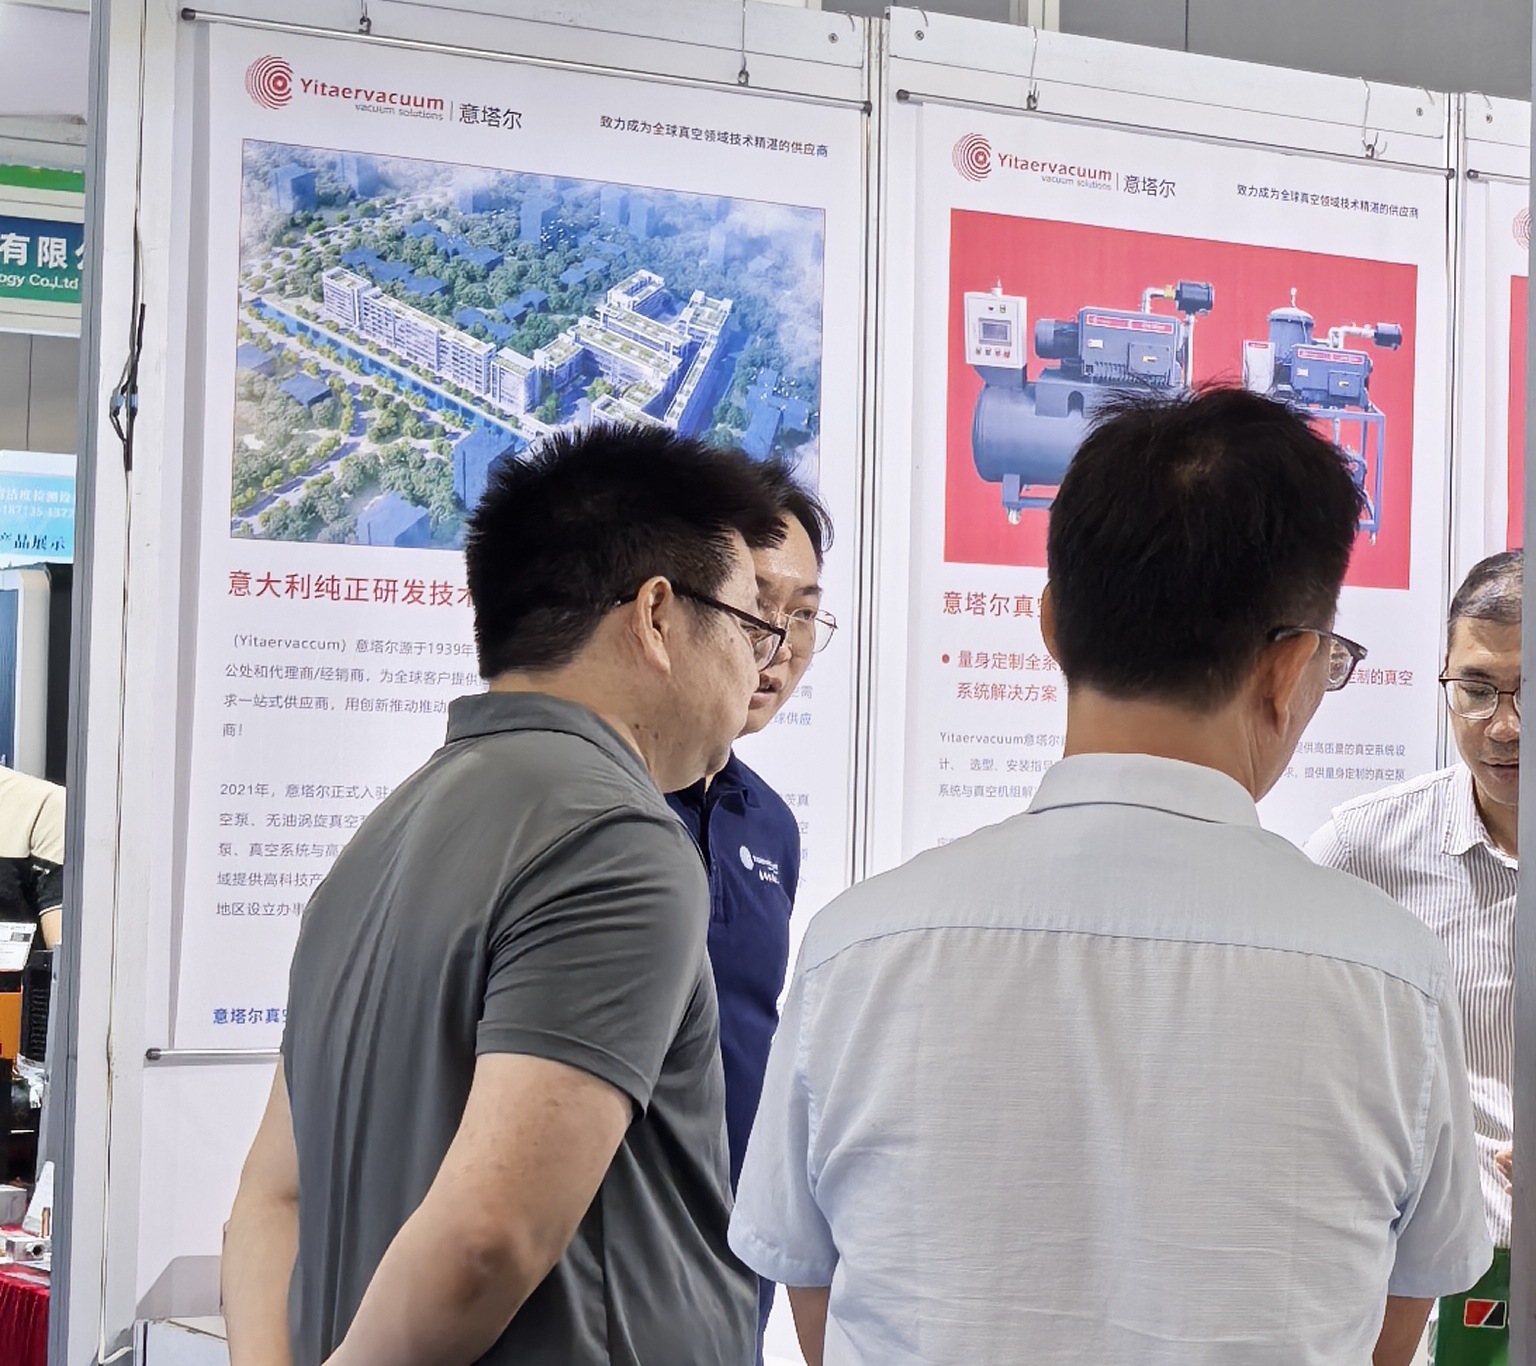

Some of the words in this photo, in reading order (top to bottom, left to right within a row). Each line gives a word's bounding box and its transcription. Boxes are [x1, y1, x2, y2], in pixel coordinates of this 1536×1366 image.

[300, 77, 444, 111] Yitaervacuum
[355, 103, 395, 116] vacuum
[398, 107, 444, 122] solutions
[459, 102, 523, 131] 意塔尔
[600, 114, 829, 158] 致力成为全球真空领域技术精湛的供应商
[998, 152, 1112, 182] Yitaervacuum
[1123, 174, 1176, 199] 意塔尔
[943, 591, 1042, 618] 意塔尔真
[957, 649, 1063, 671] 量身定制全系
[956, 682, 1058, 703] 系统解决方案
